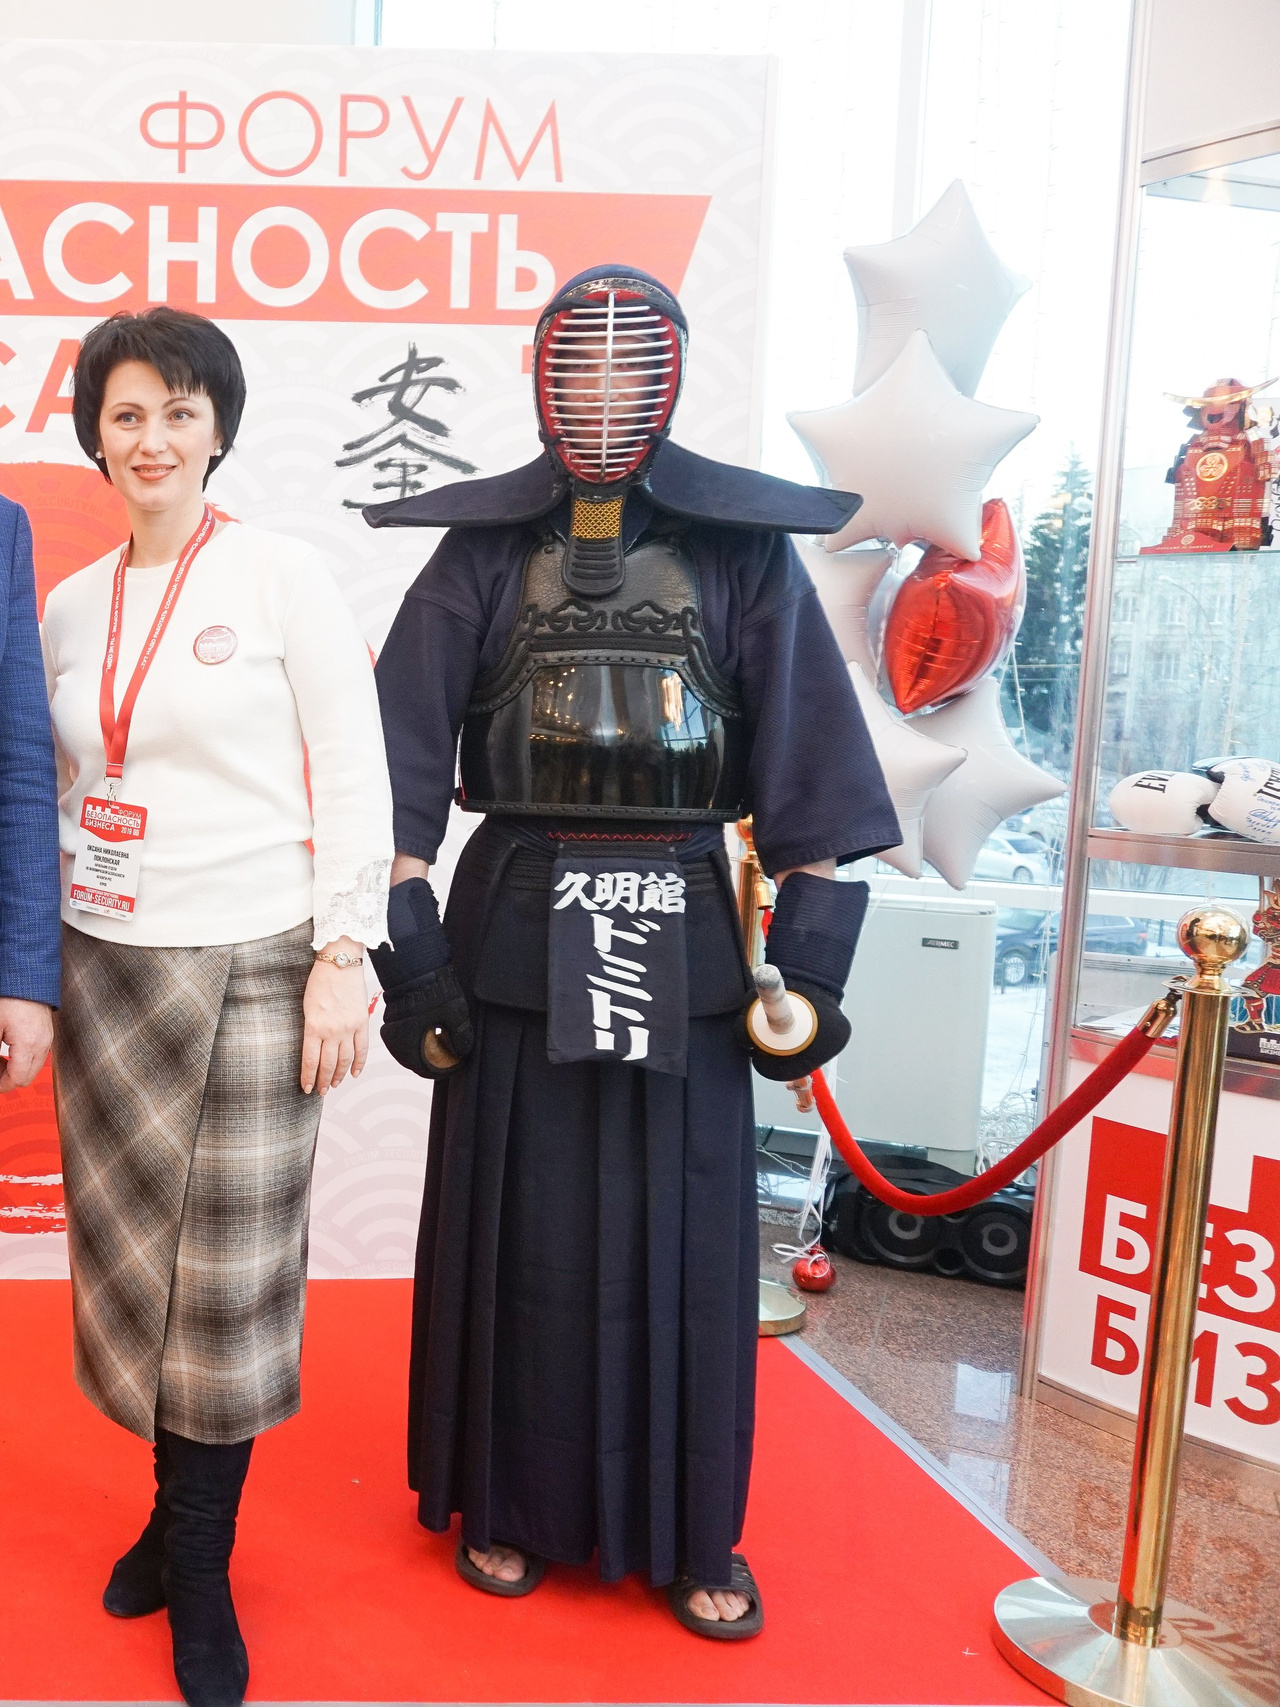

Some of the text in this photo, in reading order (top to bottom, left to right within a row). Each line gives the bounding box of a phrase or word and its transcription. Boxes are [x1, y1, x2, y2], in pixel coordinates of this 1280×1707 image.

[139, 90, 564, 183] ФОРУМ
[145, 638, 156, 655] НАДО
[153, 608, 168, 638] РАБОТАТЬ
[86, 810, 140, 828] БЕЗОПАСНОСТЬ
[118, 809, 142, 820] ФОРУМ
[85, 819, 132, 835] БИЗНЕСА 2019
[87, 844, 130, 859] ОКСАНА НИКОЛАЕВНА
[73, 889, 131, 911] FORUM-SECURITY.RU
[553, 872, 687, 914] 久明館
[586, 913, 662, 1061] ドミトリ
